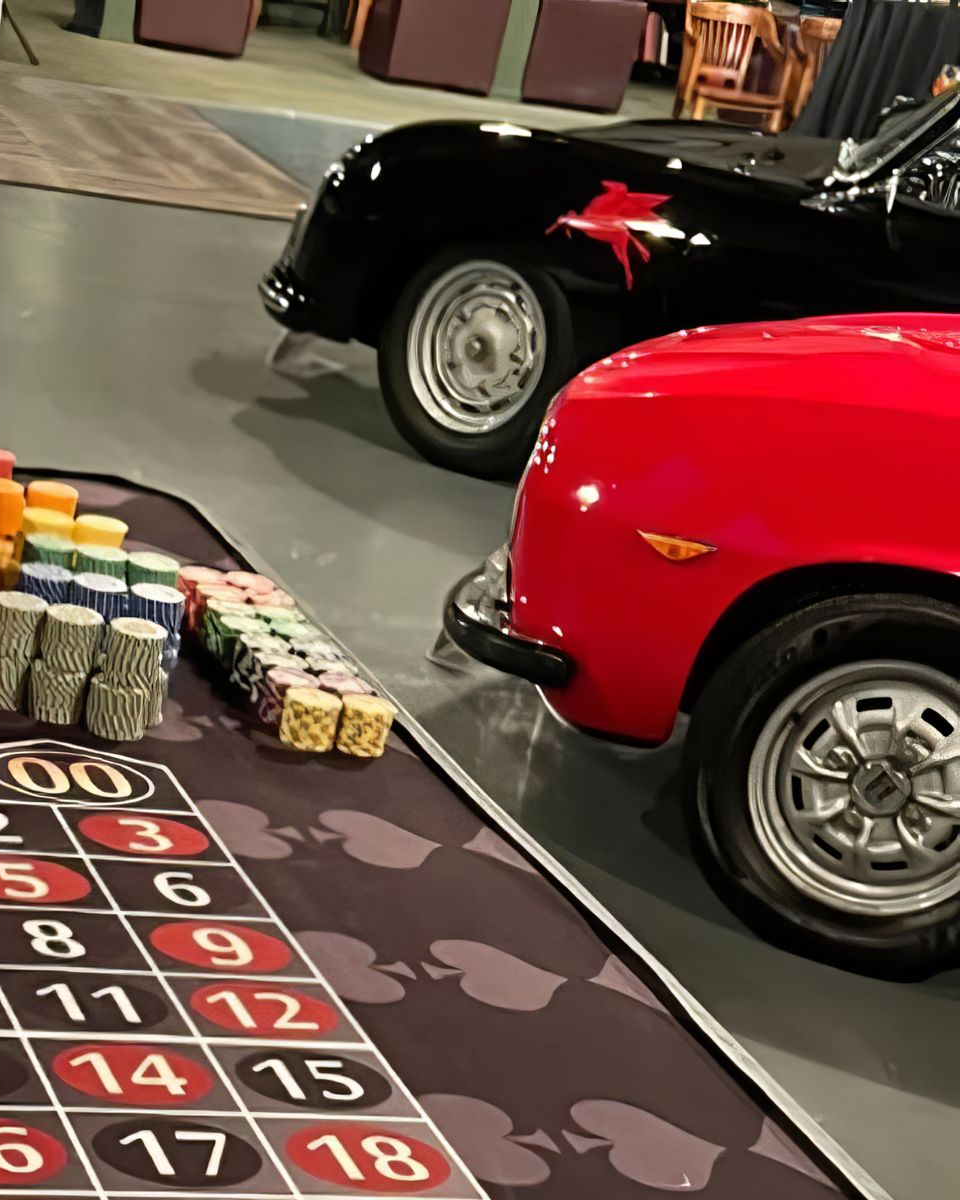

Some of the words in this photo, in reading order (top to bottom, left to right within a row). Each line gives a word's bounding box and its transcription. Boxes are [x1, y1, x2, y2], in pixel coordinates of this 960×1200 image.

[8, 757, 132, 798] 00
[118, 818, 174, 853] 3
[153, 872, 211, 906] 6
[23, 920, 86, 958] 8
[192, 928, 254, 967] 9
[36, 983, 141, 1023] 11
[206, 991, 319, 1030] 12
[69, 1052, 188, 1095] 14
[252, 1059, 364, 1100] 15
[120, 1130, 226, 1176] 17
[307, 1135, 429, 1181] 18
